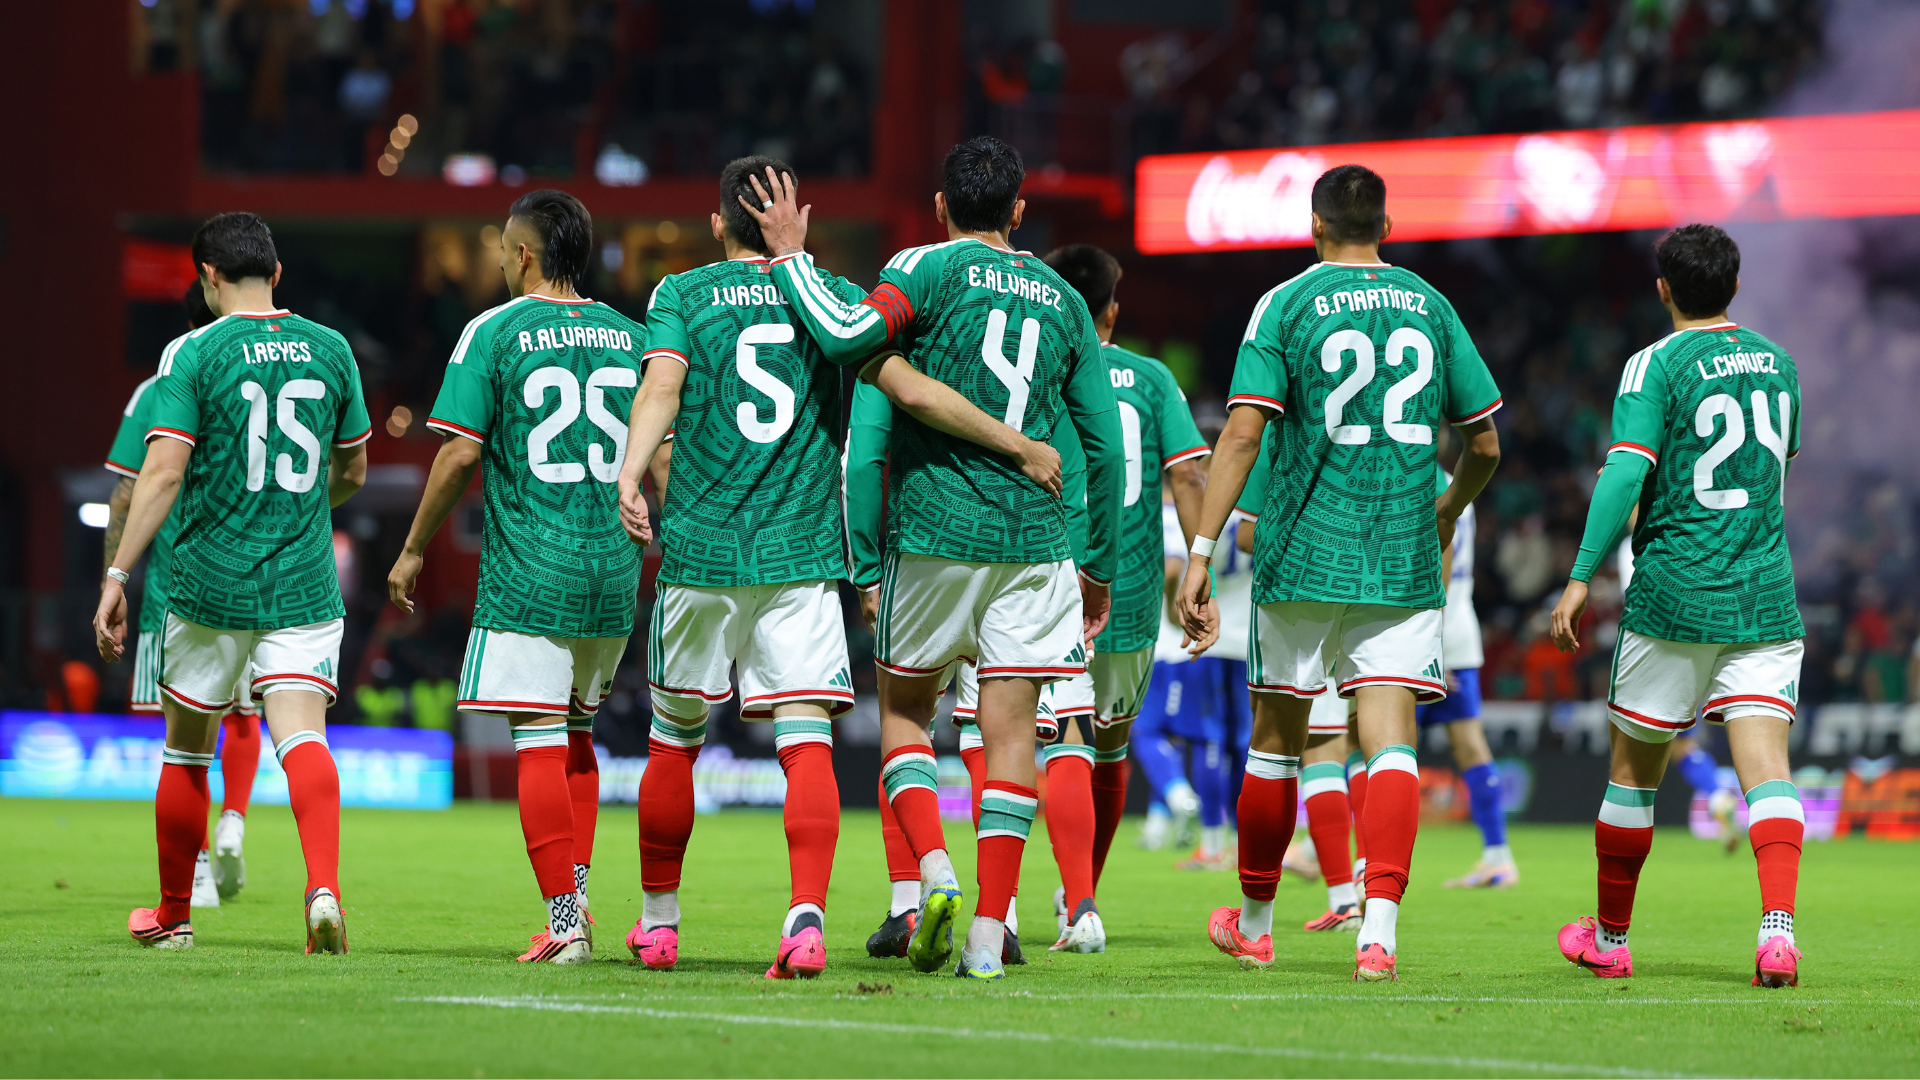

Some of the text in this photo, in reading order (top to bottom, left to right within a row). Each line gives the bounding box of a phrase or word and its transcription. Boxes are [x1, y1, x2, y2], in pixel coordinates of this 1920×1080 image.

[969, 264, 1062, 312] E.ÁLVAREZ
[1315, 284, 1428, 316] G.MARTÍNEZ
[243, 342, 311, 364] I.REYES
[519, 327, 632, 352] R.ALVARADO
[982, 309, 1040, 428] 4
[1109, 368, 1135, 388] DO
[1697, 346, 1779, 380] L.CHÁVEZ
[736, 324, 795, 443] 5
[1321, 328, 1433, 445] 22
[241, 379, 325, 493] 15
[524, 367, 637, 483] 25
[1694, 390, 1791, 509] 24
